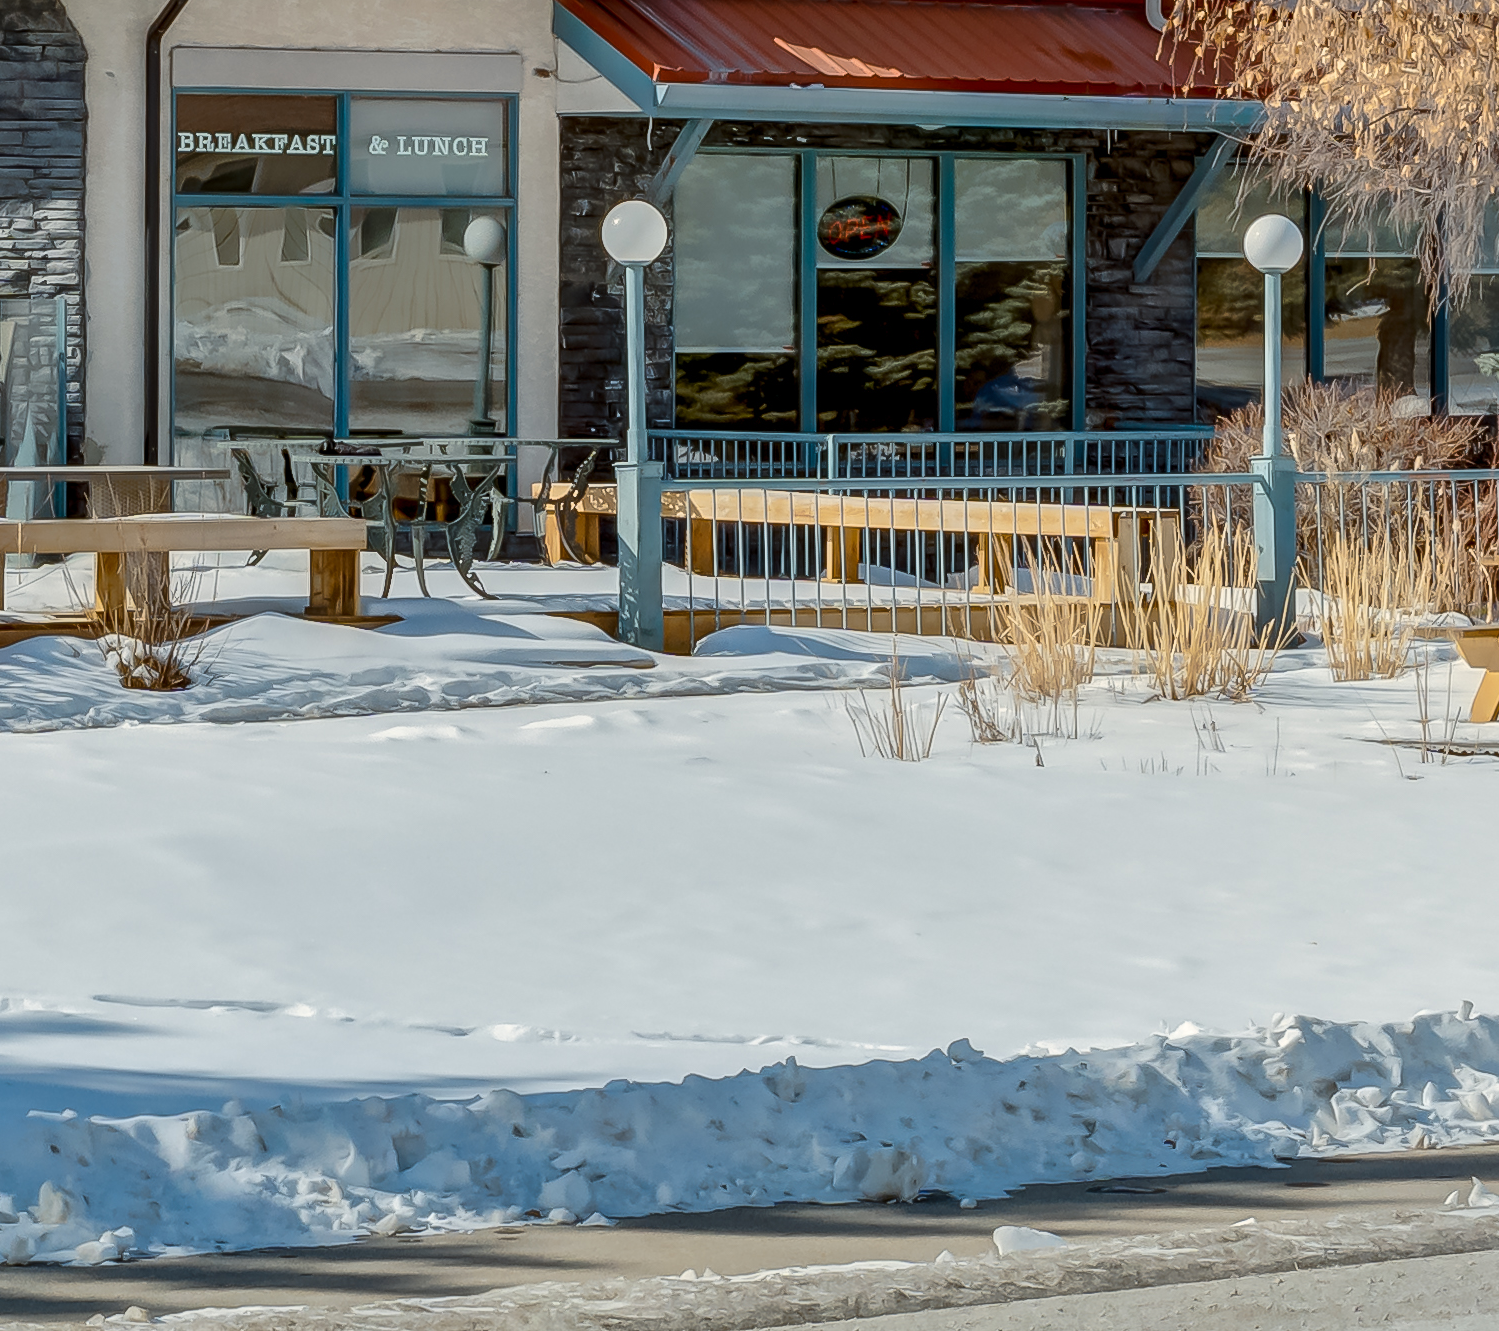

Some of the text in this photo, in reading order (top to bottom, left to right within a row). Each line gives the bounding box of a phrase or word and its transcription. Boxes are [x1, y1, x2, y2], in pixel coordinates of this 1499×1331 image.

[177, 132, 489, 157] BREAKFAST & LUNCH
[828, 214, 891, 245] OPEN
